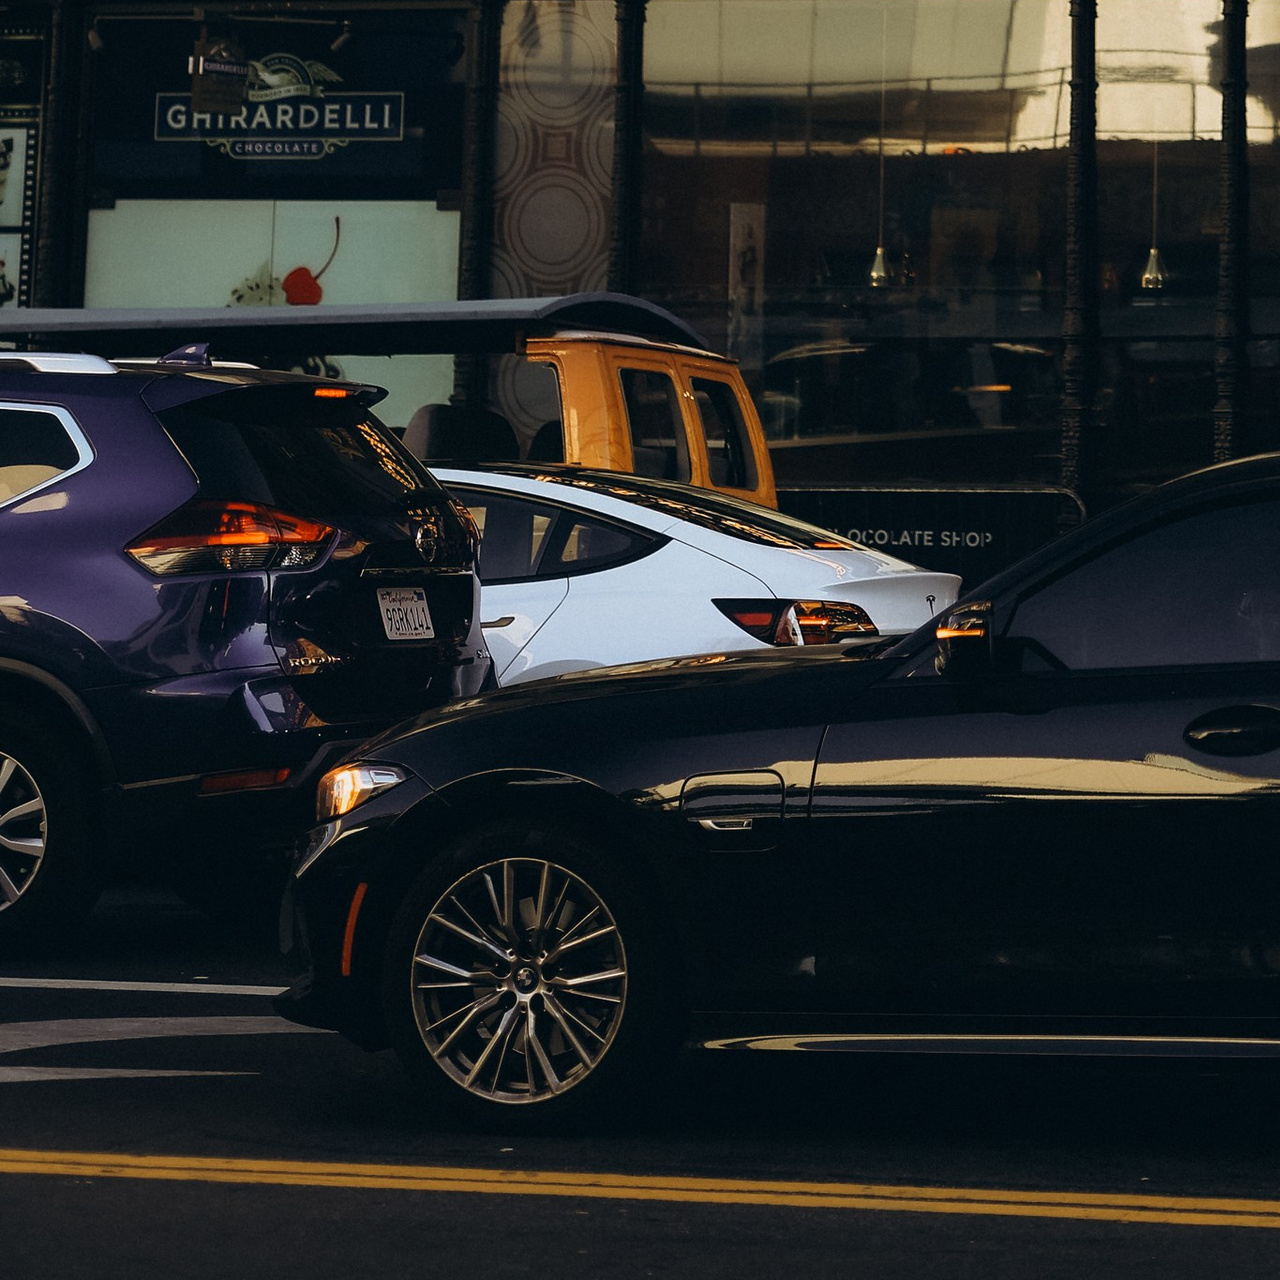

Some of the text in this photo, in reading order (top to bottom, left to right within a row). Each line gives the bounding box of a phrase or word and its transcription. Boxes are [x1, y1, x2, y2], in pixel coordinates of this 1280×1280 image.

[166, 103, 392, 130] GHIRARDELLI
[234, 142, 320, 154] CHOCOLATE
[827, 528, 993, 547] OCOLATE SHOP
[386, 607, 431, 631] 9GRK141
